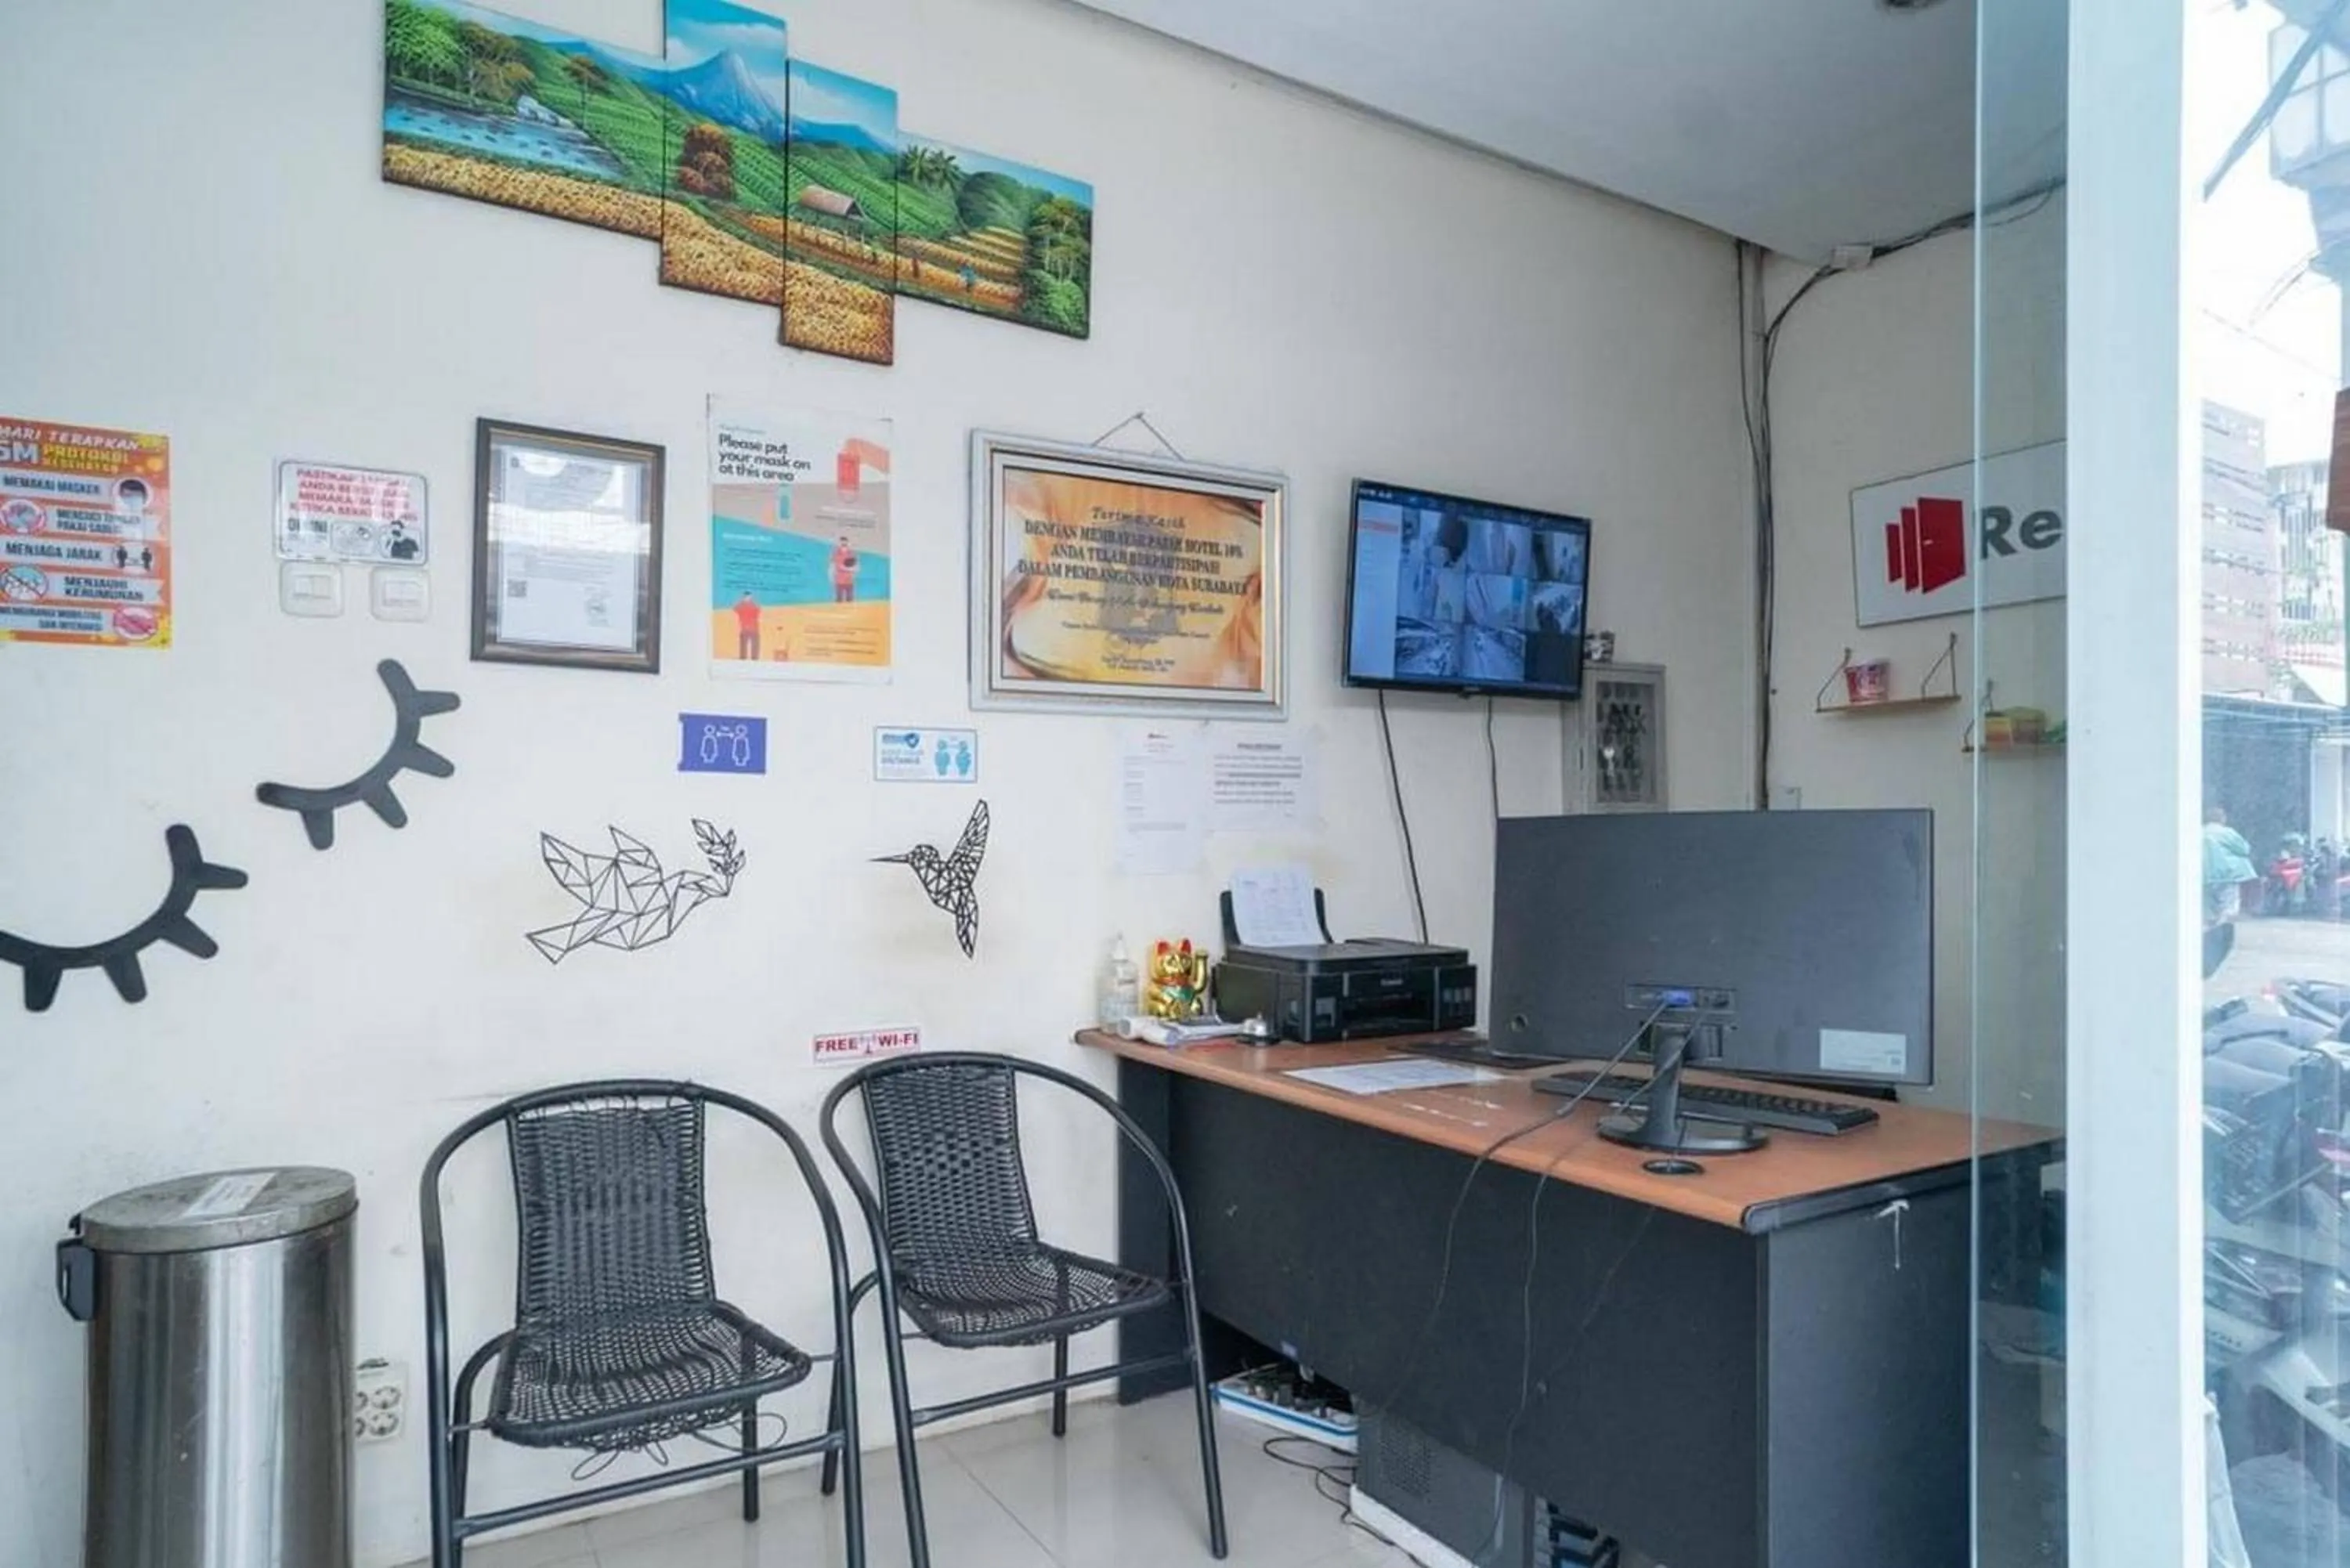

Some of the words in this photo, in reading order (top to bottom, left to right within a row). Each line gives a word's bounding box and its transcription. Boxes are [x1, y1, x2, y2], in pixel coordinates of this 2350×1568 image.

[49, 432, 139, 450] TERAPKAN
[719, 433, 763, 451] Please
[765, 442, 787, 454] put
[718, 451, 753, 462] your
[754, 455, 791, 468] mask
[793, 459, 811, 470] on
[718, 464, 733, 474] at
[736, 464, 760, 477] this
[762, 470, 794, 482] area
[5, 540, 63, 558] MENJAGA
[67, 546, 103, 562] JARAK
[1050, 544, 1085, 560] ANDA
[1184, 537, 1223, 556] HOTEL
[1018, 558, 1062, 578] DALAM
[815, 1038, 858, 1052] FREE
[878, 1033, 918, 1047] WI-FI
